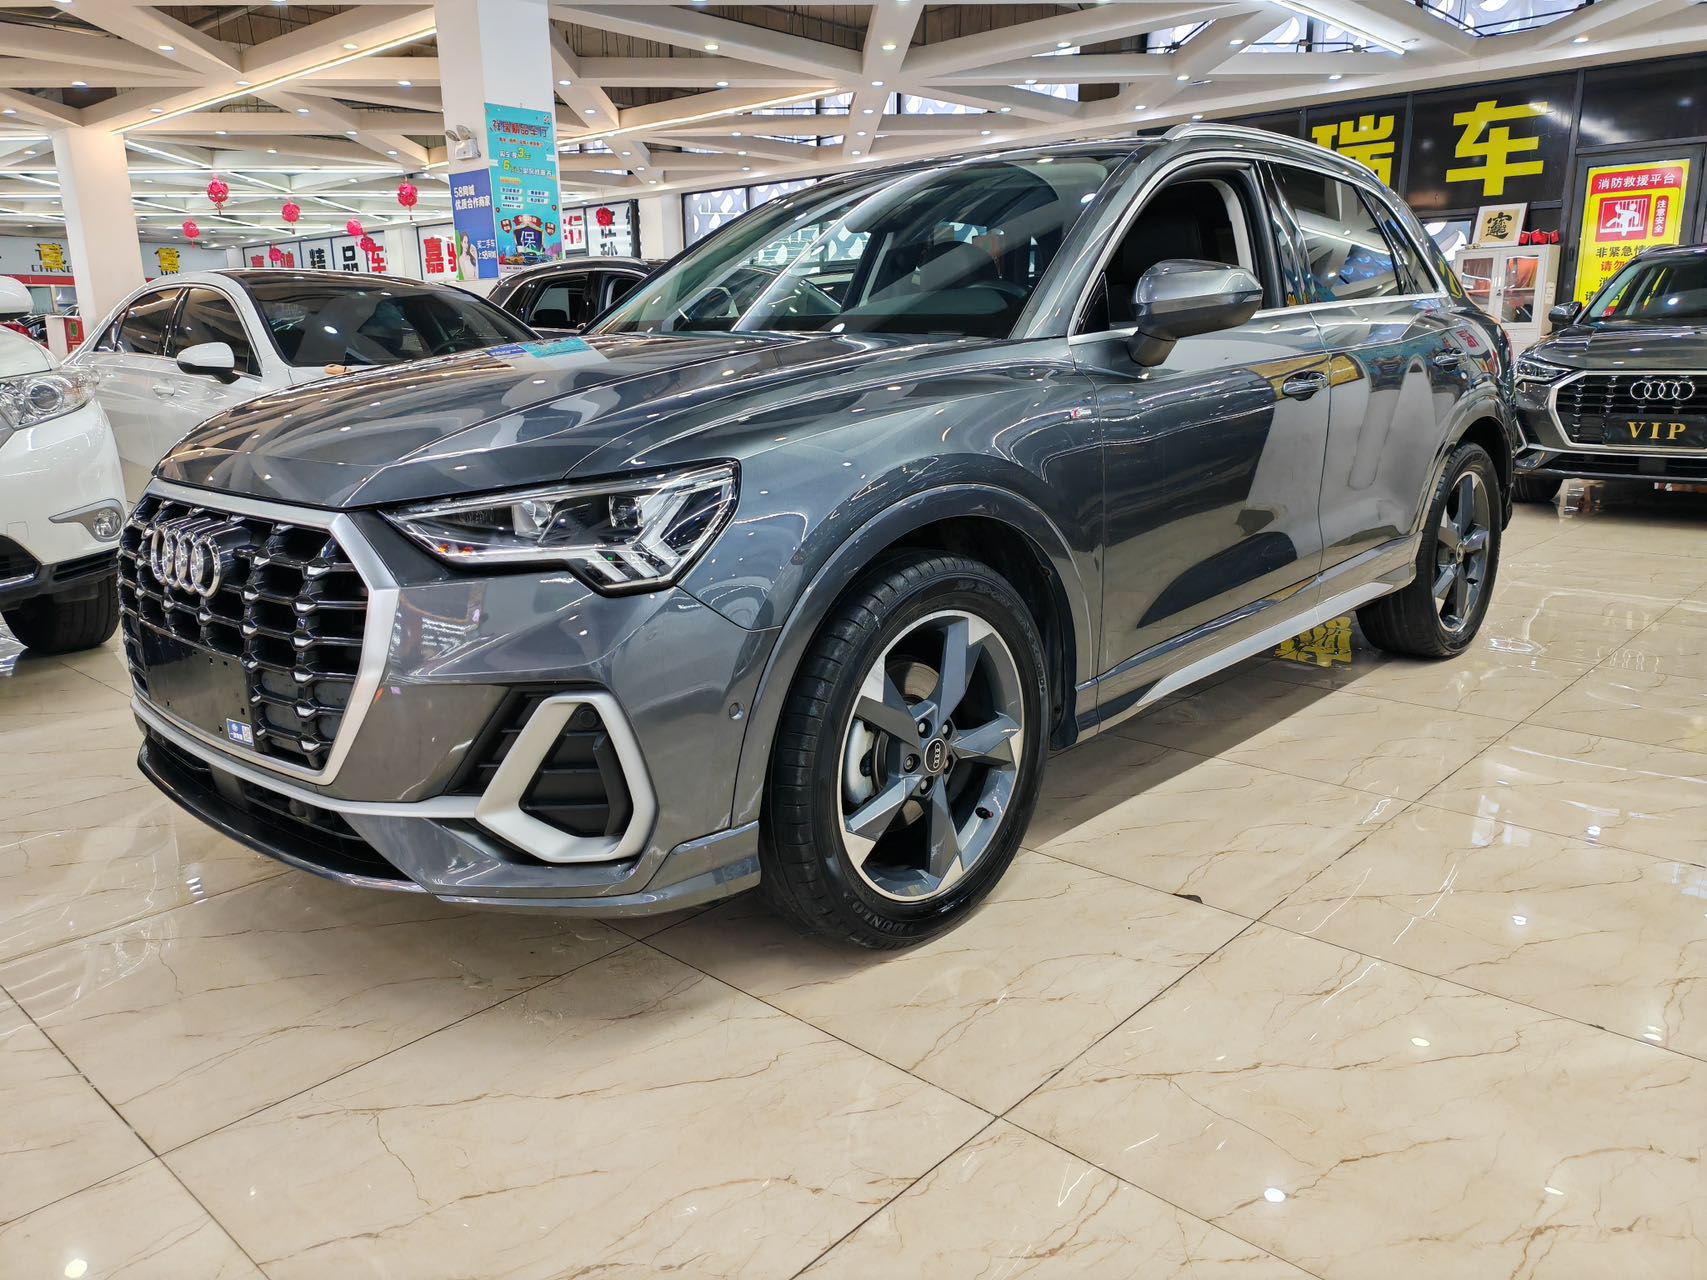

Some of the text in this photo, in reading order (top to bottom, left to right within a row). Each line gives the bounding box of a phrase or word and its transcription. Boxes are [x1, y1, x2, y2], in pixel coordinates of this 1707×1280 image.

[1597, 172, 1675, 190] 消防救援平台
[1653, 200, 1667, 233] 注意安全
[520, 230, 536, 249] 保
[1627, 421, 1686, 440] VIP
